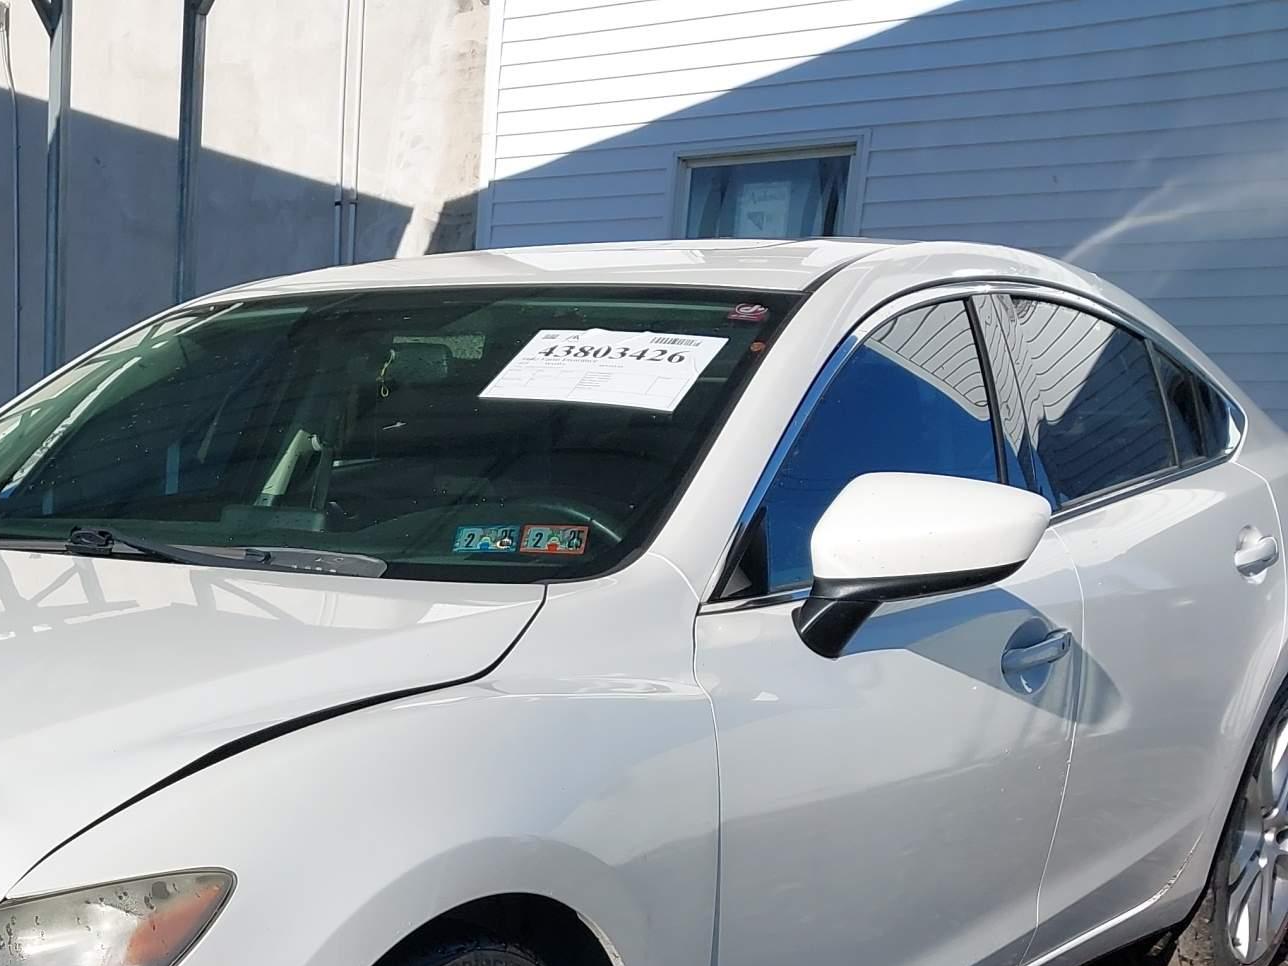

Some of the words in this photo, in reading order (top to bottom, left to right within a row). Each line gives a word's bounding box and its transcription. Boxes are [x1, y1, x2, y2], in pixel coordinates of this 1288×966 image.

[538, 344, 689, 364] 43803426
[465, 532, 476, 548] 2
[533, 532, 544, 548] 2
[567, 530, 583, 549] 25
